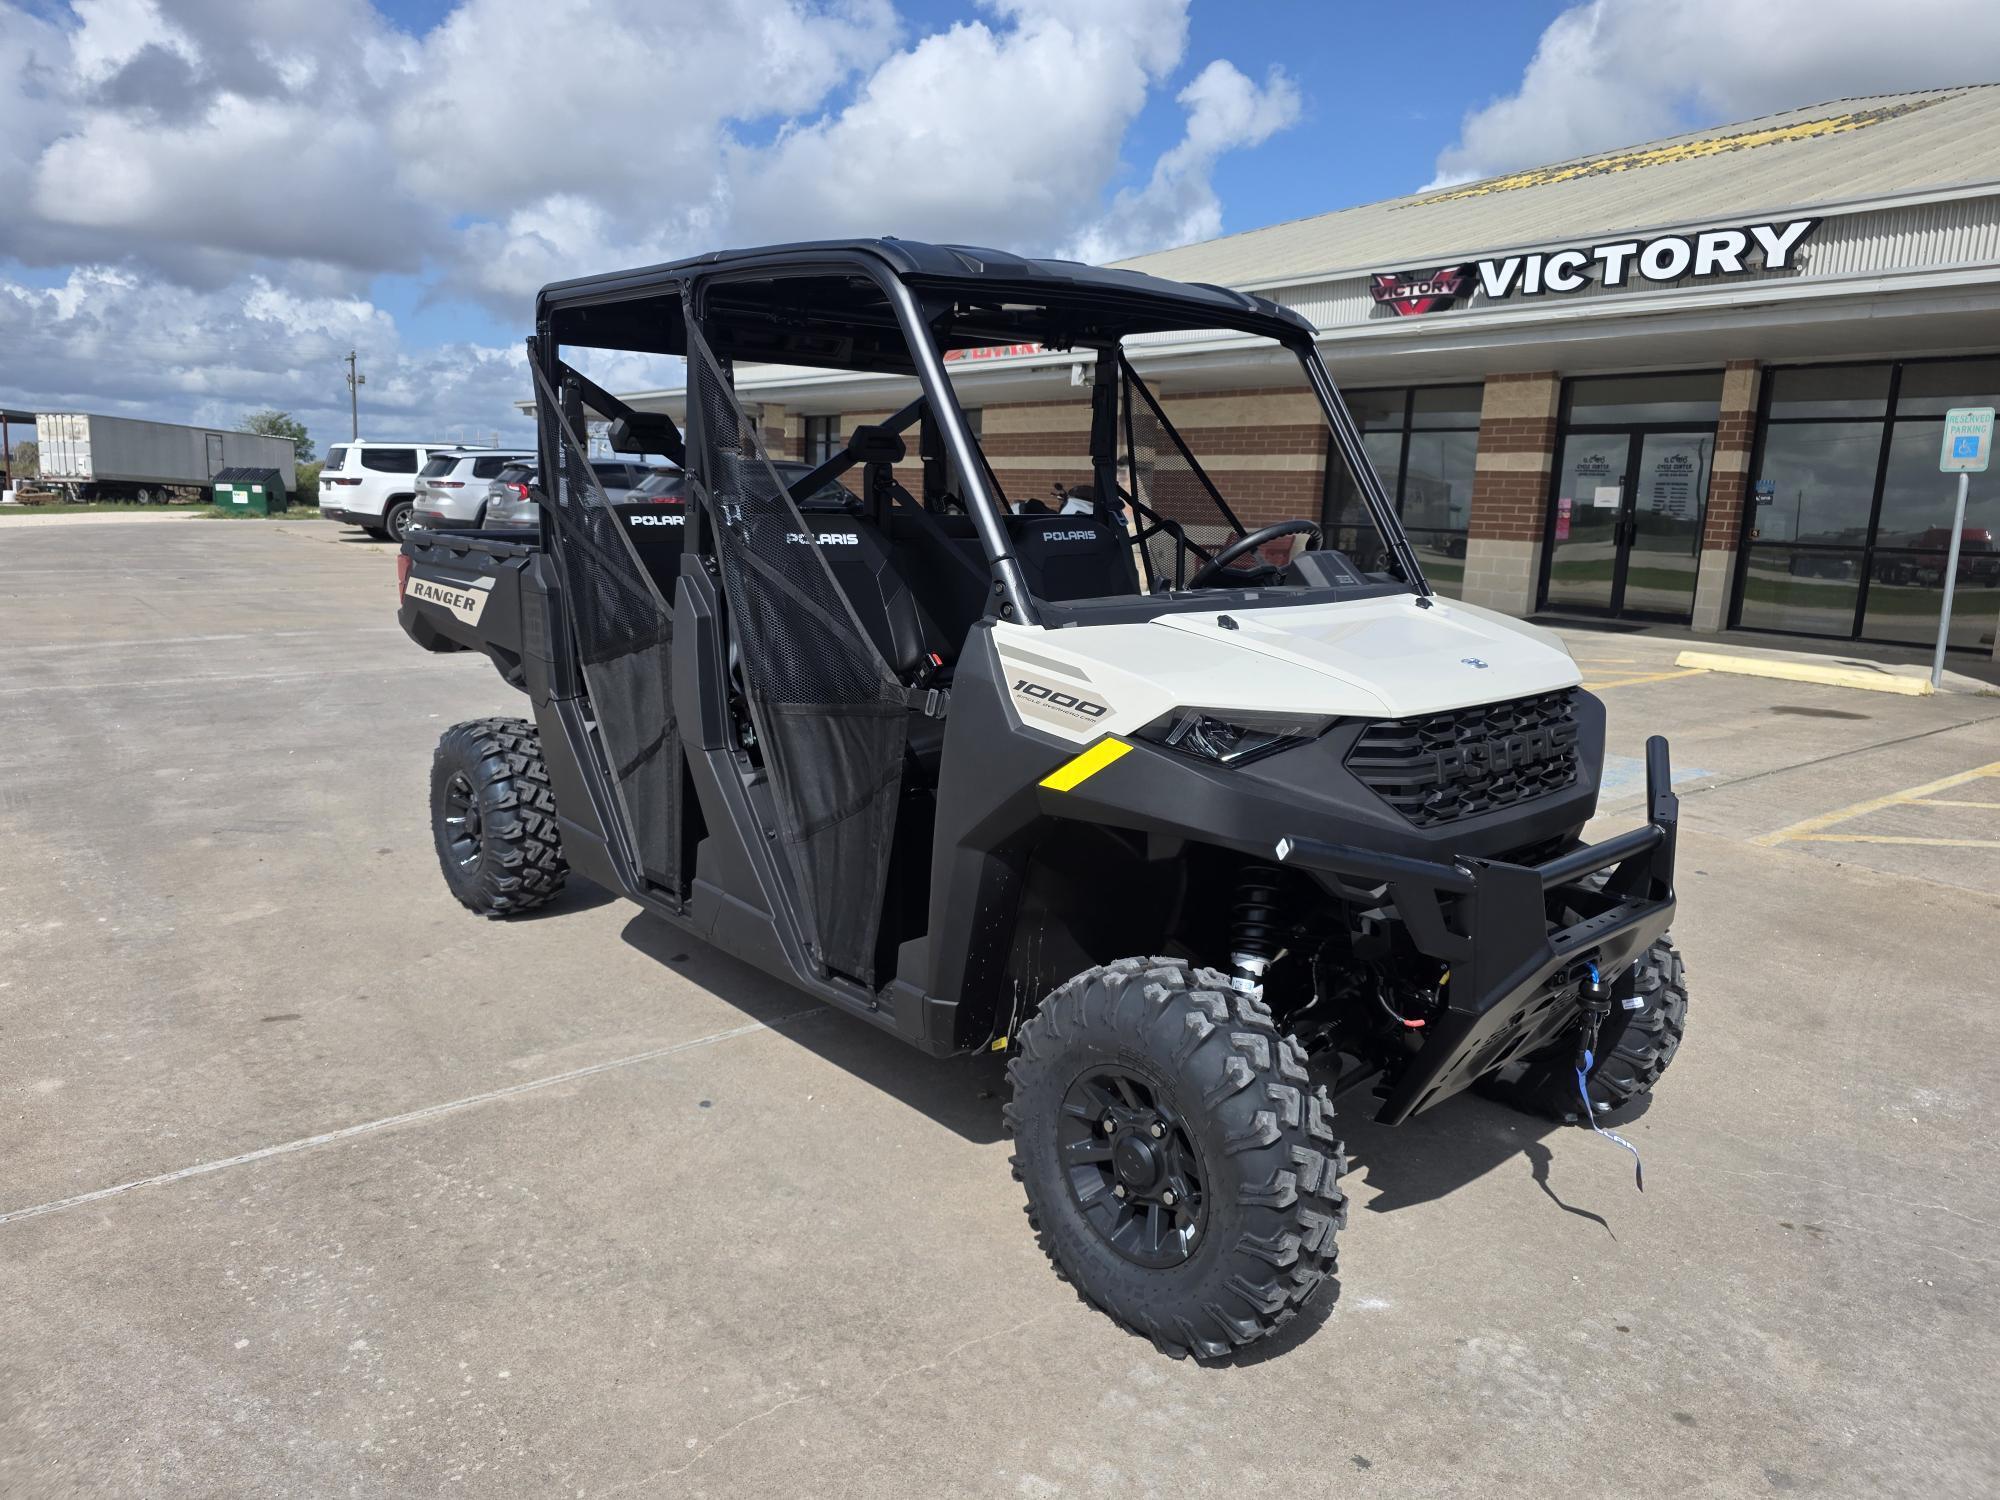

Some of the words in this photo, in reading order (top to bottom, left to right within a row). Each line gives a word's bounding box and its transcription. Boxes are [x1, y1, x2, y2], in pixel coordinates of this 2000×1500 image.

[1476, 219, 1814, 299] VICTORY
[1374, 279, 1460, 298] VICTORY
[1949, 414, 1991, 424] RESERVED
[1950, 425, 1987, 434] PARKING
[630, 515, 686, 526] POLAR
[1042, 530, 1097, 542] POLARIS
[414, 583, 476, 612] RANGER
[1013, 680, 1107, 718] 1000
[1436, 719, 1579, 785] POLARIS
